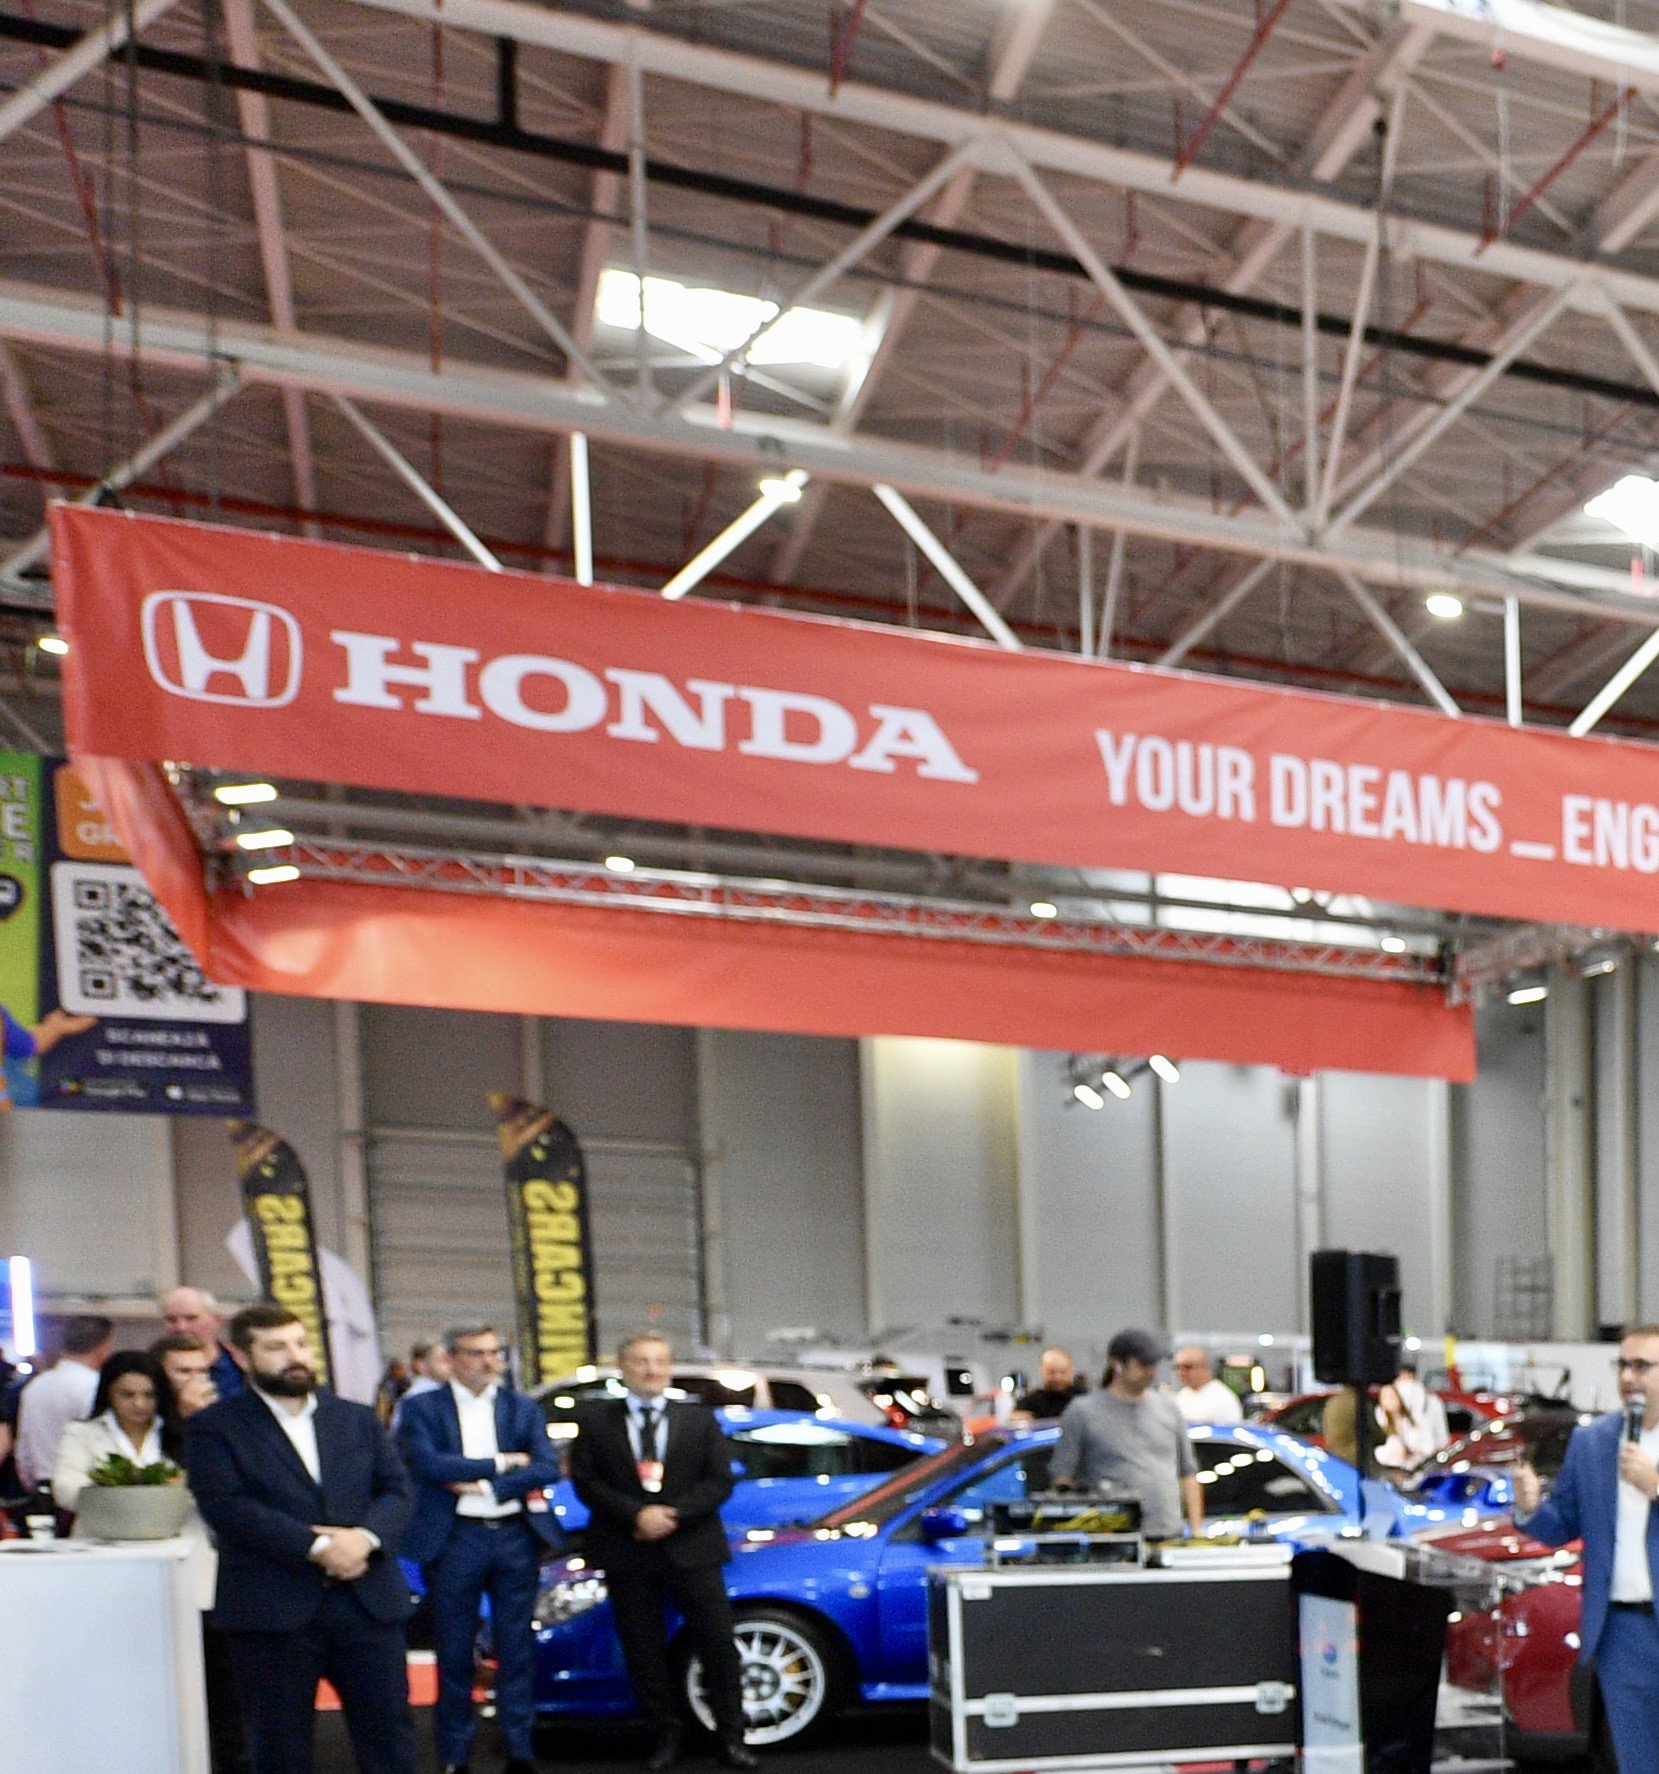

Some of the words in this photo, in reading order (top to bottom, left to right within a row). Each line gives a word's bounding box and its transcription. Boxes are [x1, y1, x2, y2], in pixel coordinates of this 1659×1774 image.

[330, 630, 979, 783] HONDA
[1094, 729, 1256, 822] YOUR
[1269, 754, 1503, 855] DREAMS
